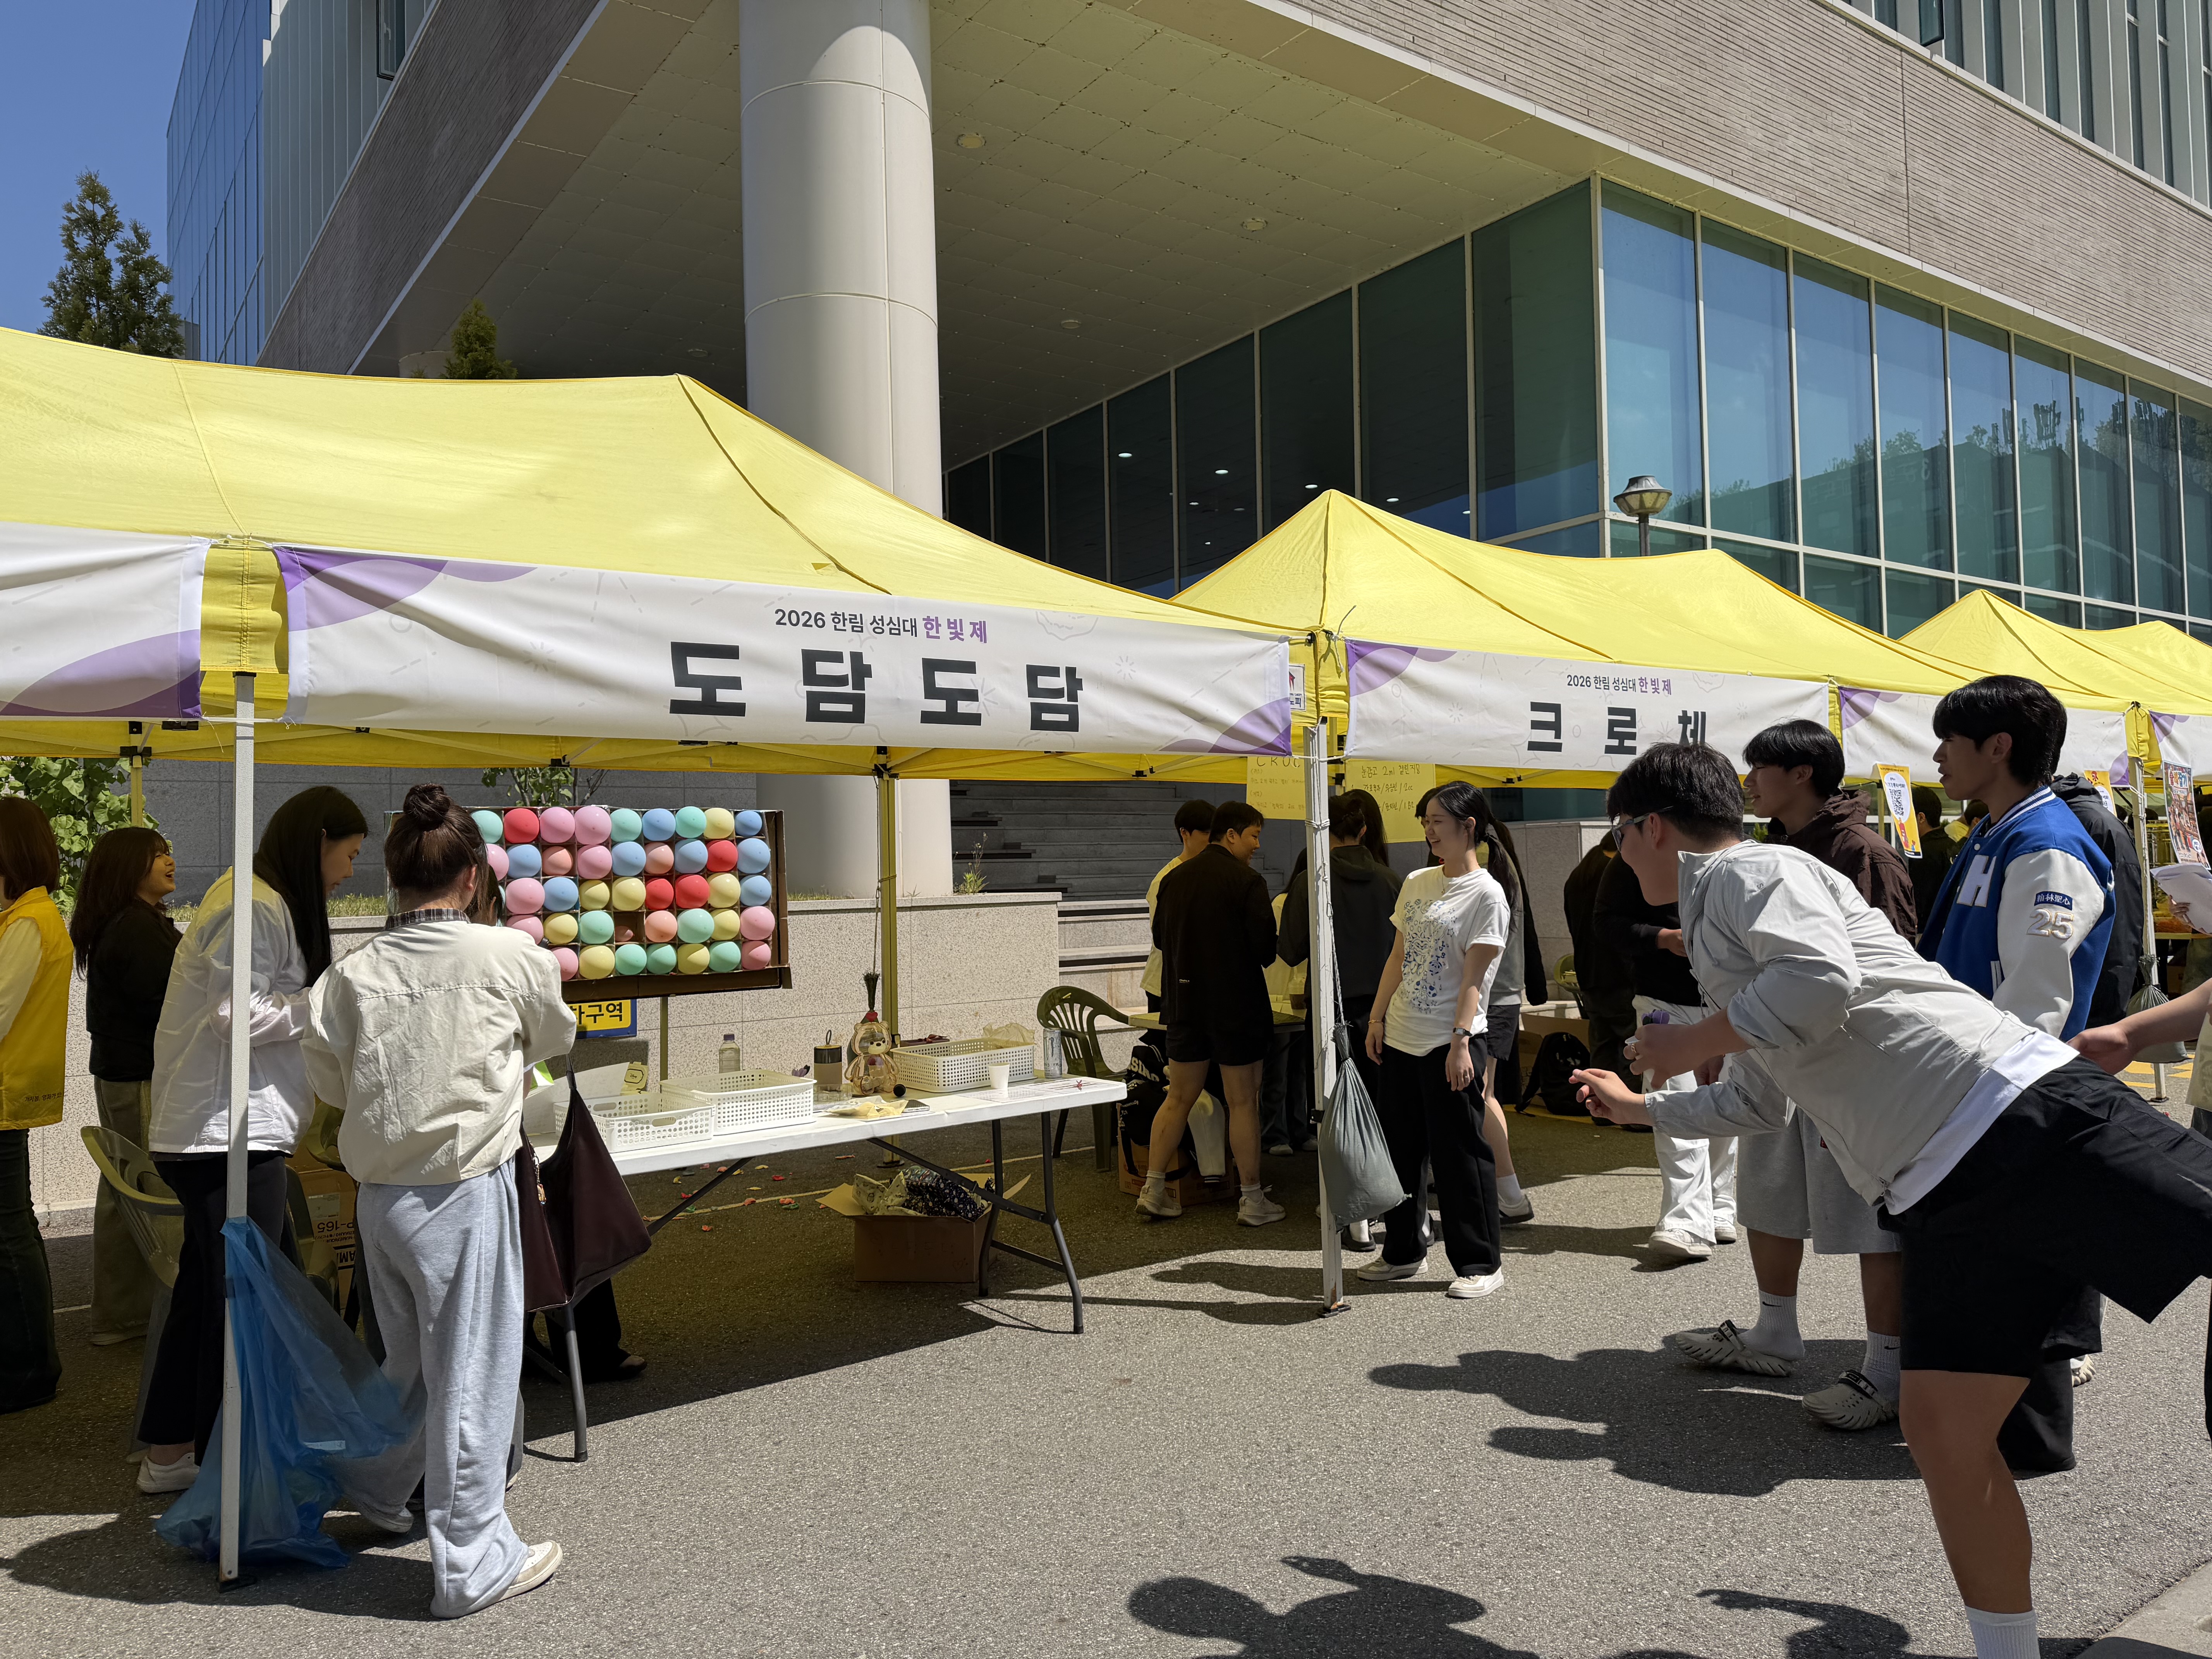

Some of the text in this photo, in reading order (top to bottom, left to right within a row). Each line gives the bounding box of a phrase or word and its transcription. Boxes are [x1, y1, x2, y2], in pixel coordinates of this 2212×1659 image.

[775, 608, 826, 629] 2026
[830, 611, 864, 633] 한림
[869, 614, 917, 637] 성심대
[1566, 674, 1591, 688] 2026
[1593, 675, 1610, 690] 한림
[1612, 677, 1637, 693] 성심대
[1361, 765, 1378, 778] 눈감고
[1956, 855, 1997, 908] H
[2026, 908, 2074, 940] 25
